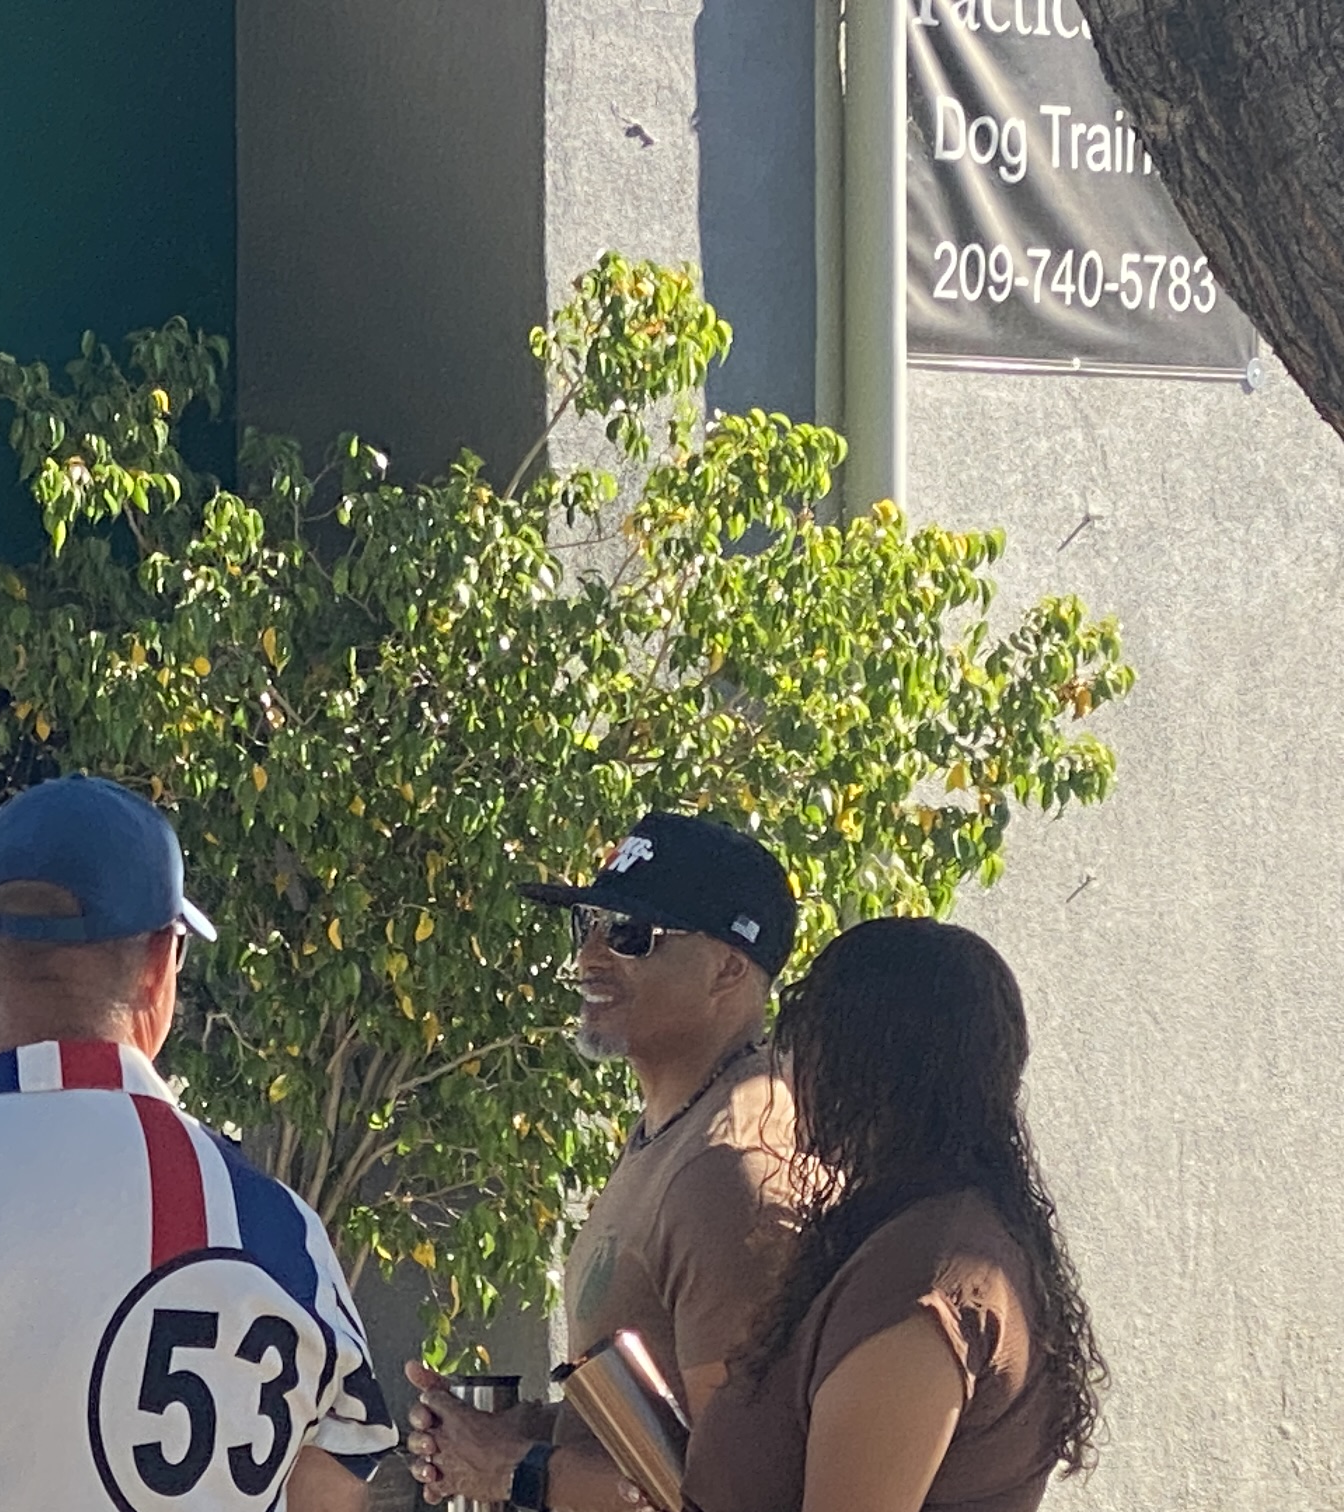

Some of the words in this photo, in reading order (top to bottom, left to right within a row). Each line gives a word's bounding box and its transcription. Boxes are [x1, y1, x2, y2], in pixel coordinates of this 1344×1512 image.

[934, 95, 1028, 184] Dog
[932, 240, 1217, 314] 209-740-5783
[132, 1308, 300, 1497] 53
